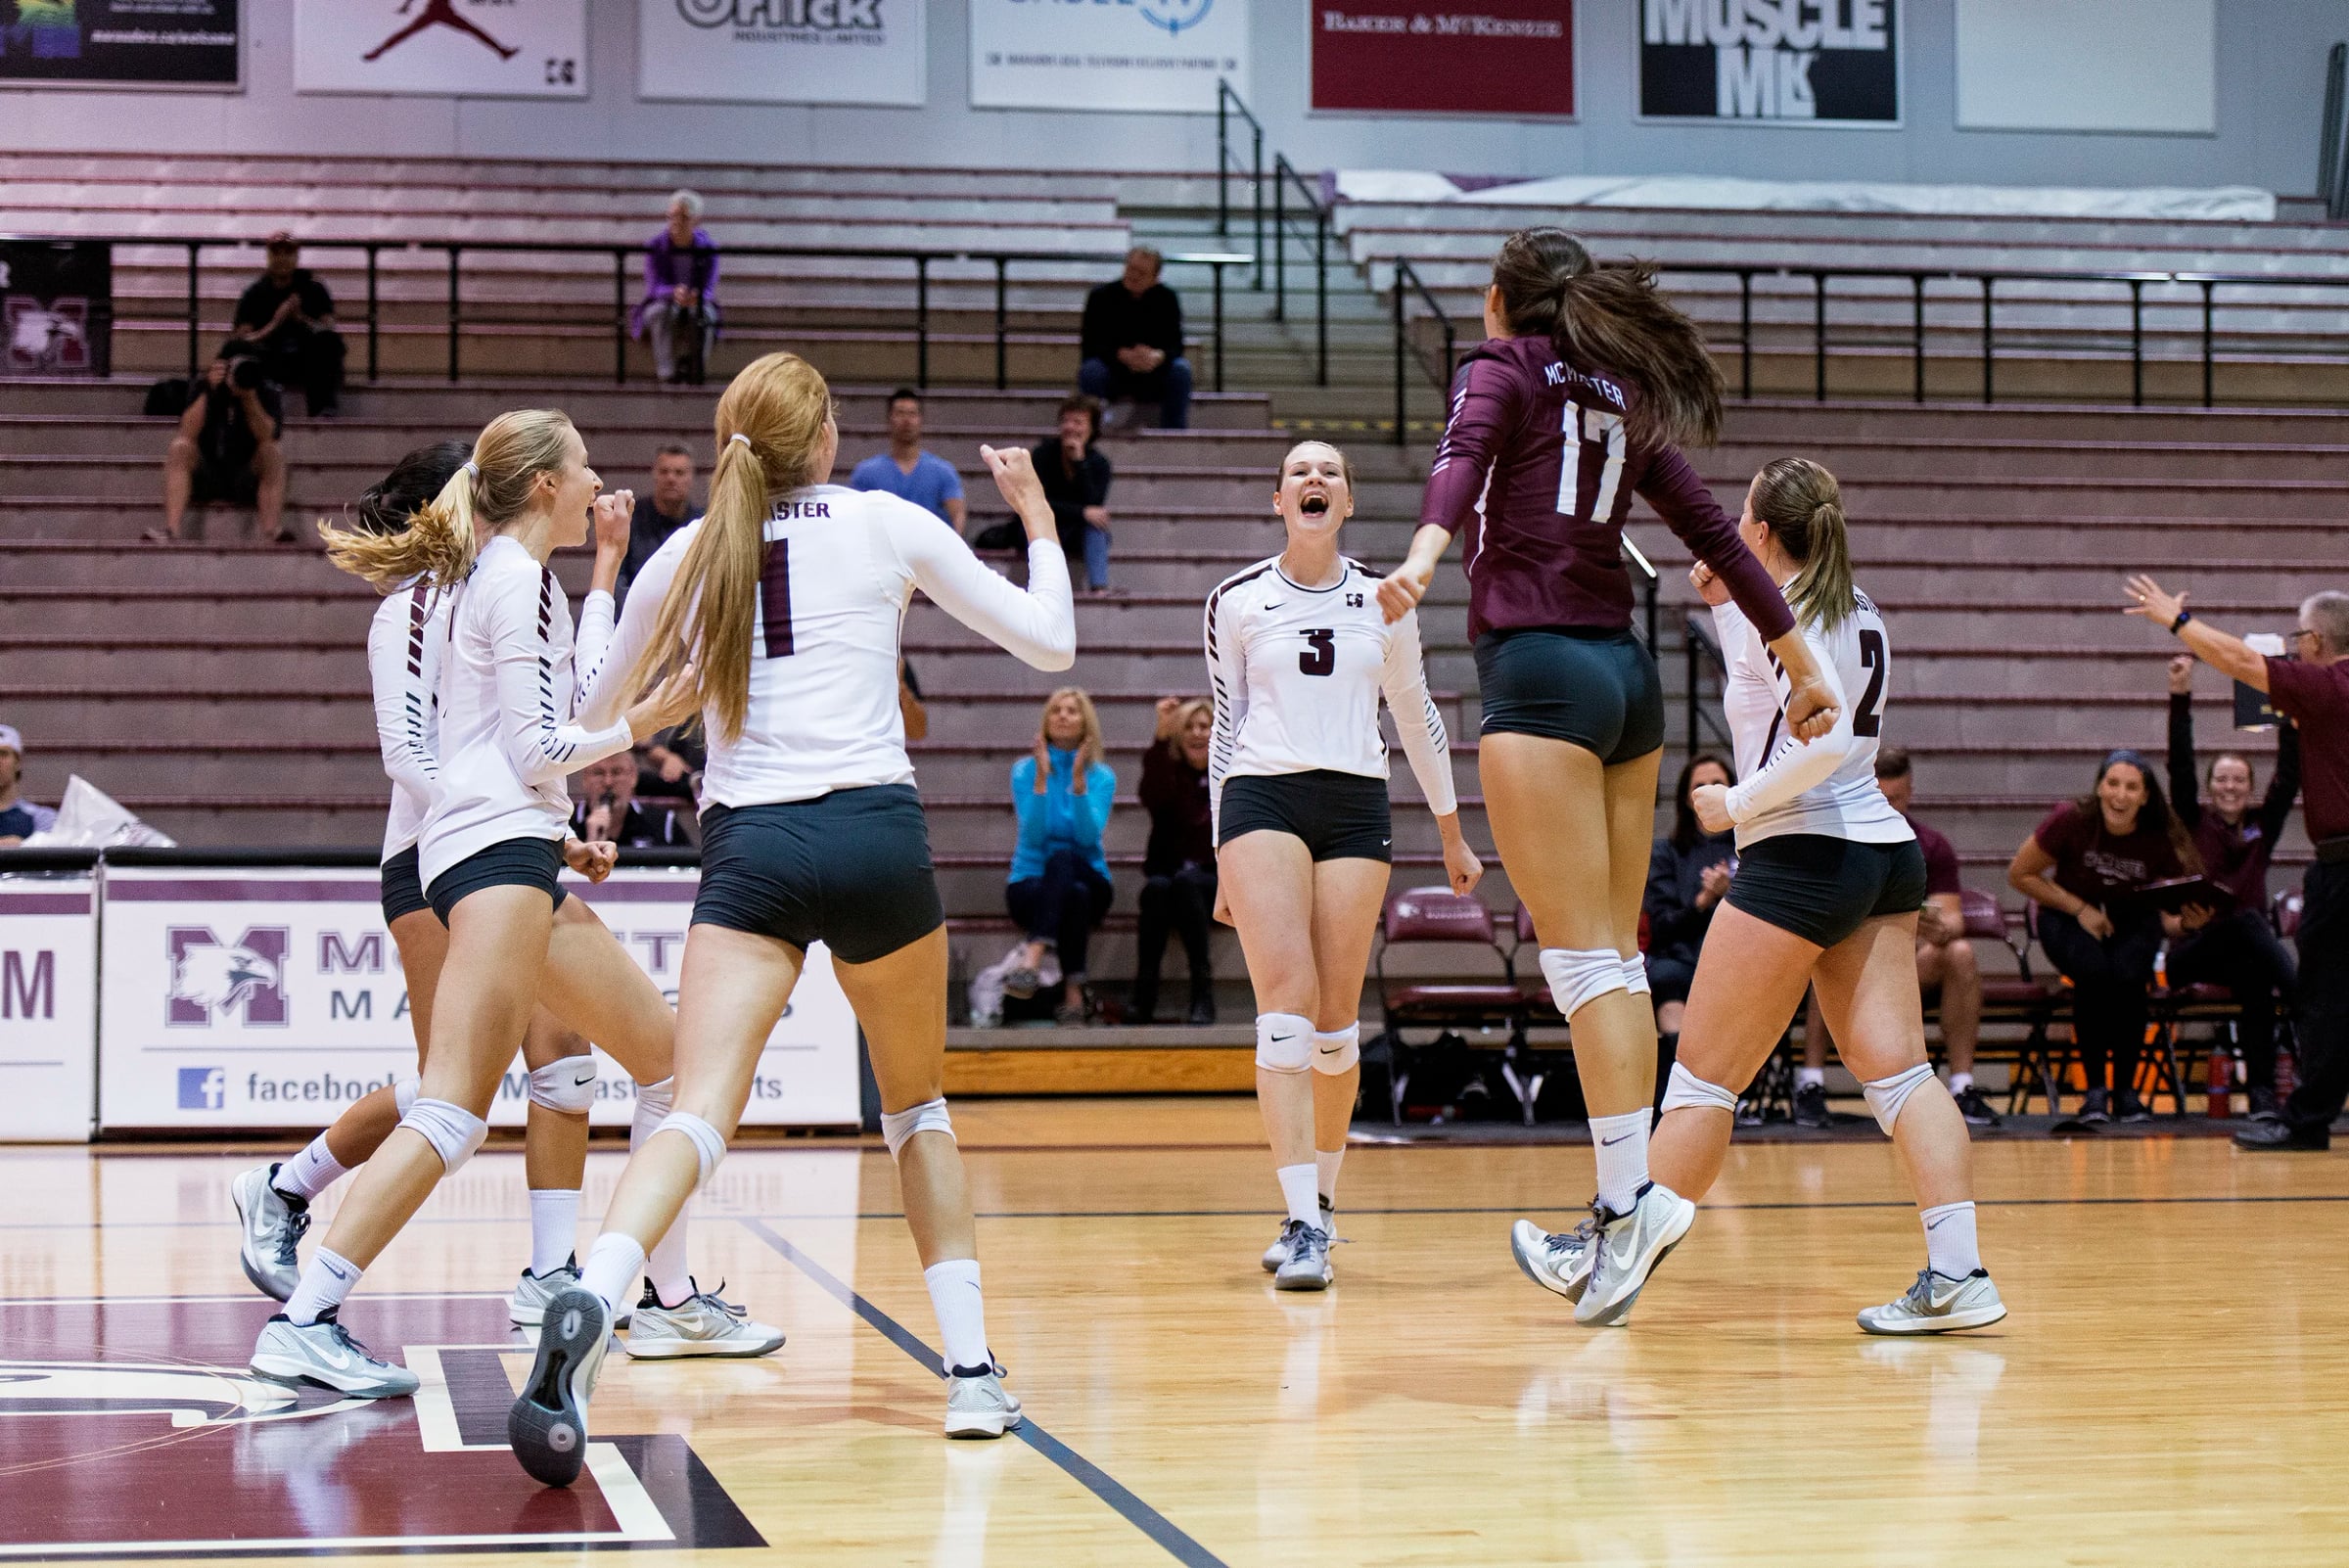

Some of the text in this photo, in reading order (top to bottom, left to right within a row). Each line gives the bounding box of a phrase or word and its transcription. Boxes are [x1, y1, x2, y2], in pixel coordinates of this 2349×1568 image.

[1409, 14, 1433, 34] &
[1644, 0, 1888, 48] MUSCLE
[1556, 398, 1627, 524] 17
[1299, 628, 1335, 676] 3
[1853, 629, 1885, 737] 2
[248, 1073, 394, 1100] faceboo
